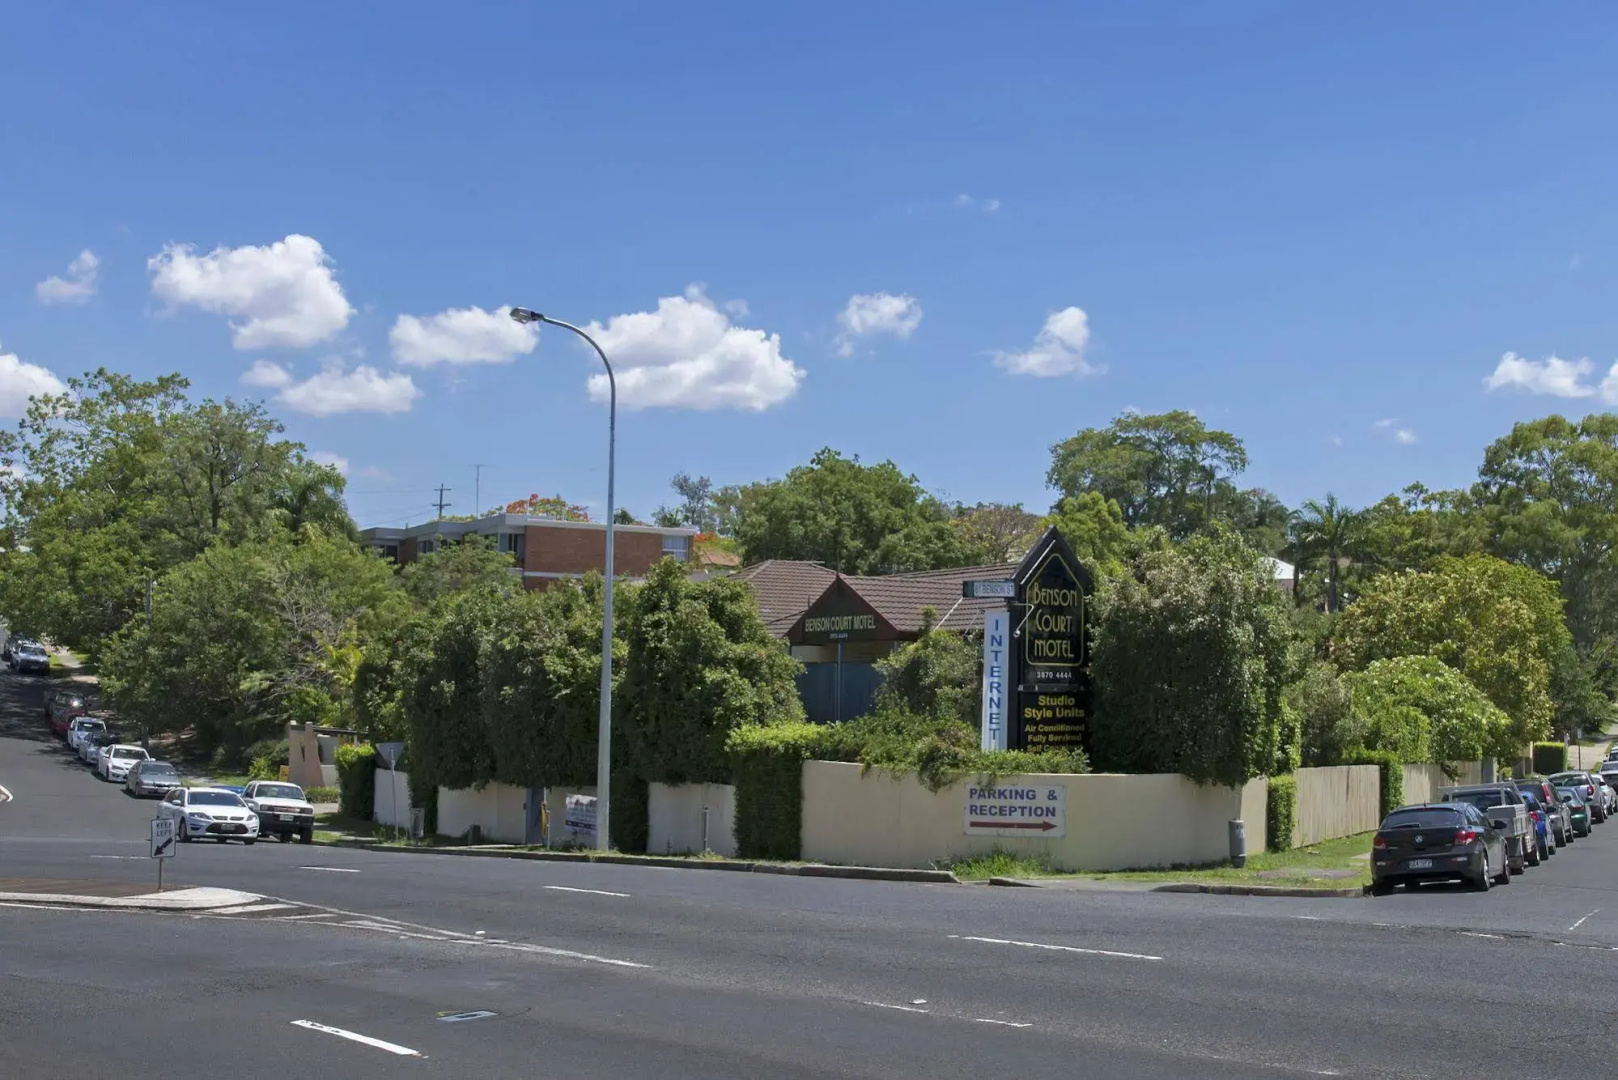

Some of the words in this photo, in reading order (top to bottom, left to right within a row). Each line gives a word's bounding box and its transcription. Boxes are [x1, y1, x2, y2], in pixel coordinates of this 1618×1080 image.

[982, 584, 1006, 595] BENSON
[1033, 582, 1077, 606] BENSON
[805, 617, 830, 632] BENSON
[830, 616, 853, 631] COURT
[853, 615, 876, 630] MOTEL
[1035, 609, 1072, 632] COURT
[1034, 639, 1074, 657] MOTEL
[989, 619, 1002, 740] INTERNET
[1055, 671, 1072, 679] 4444
[1038, 695, 1075, 706] Studio
[1024, 707, 1053, 720] Style
[1056, 707, 1085, 718] Units
[1024, 724, 1037, 732] Air
[1038, 723, 1085, 732] Conditioned
[1027, 734, 1047, 744] Fully
[969, 788, 1036, 800] PARKING
[1047, 789, 1058, 801] &
[969, 804, 1056, 817] RECEPTION
